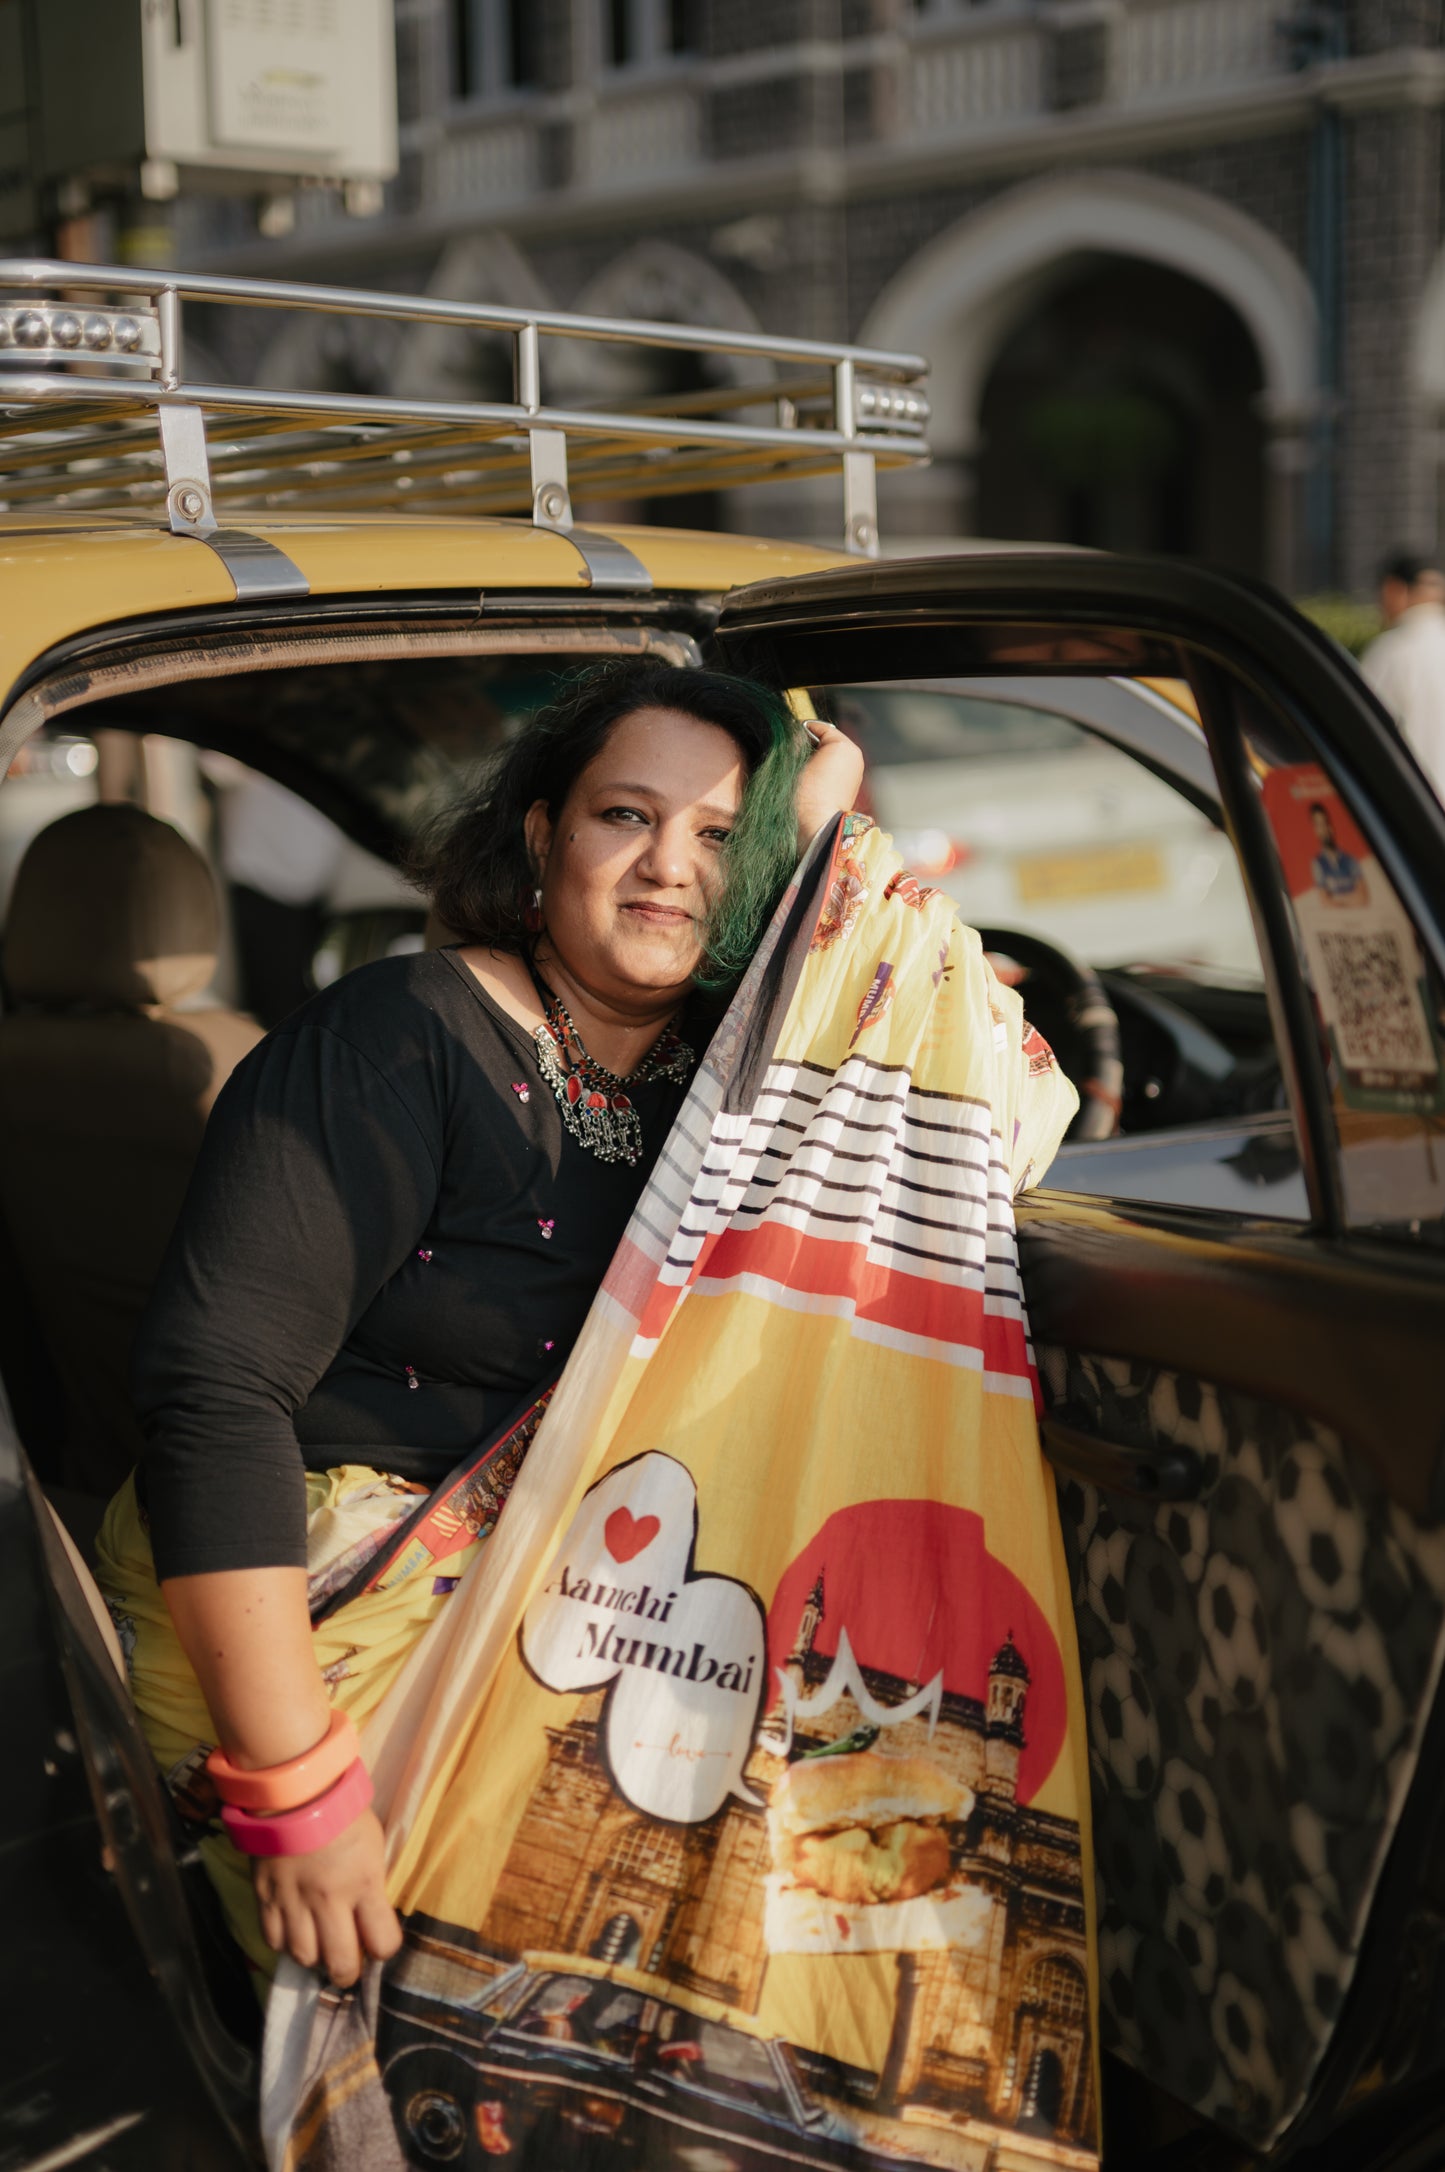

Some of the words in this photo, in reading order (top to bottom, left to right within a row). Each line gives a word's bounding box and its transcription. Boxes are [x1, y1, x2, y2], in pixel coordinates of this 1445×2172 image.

[386, 1543, 429, 1589] MUMBAI
[544, 1565, 678, 1622] Aamchi
[576, 1622, 756, 1693] Mumbai
